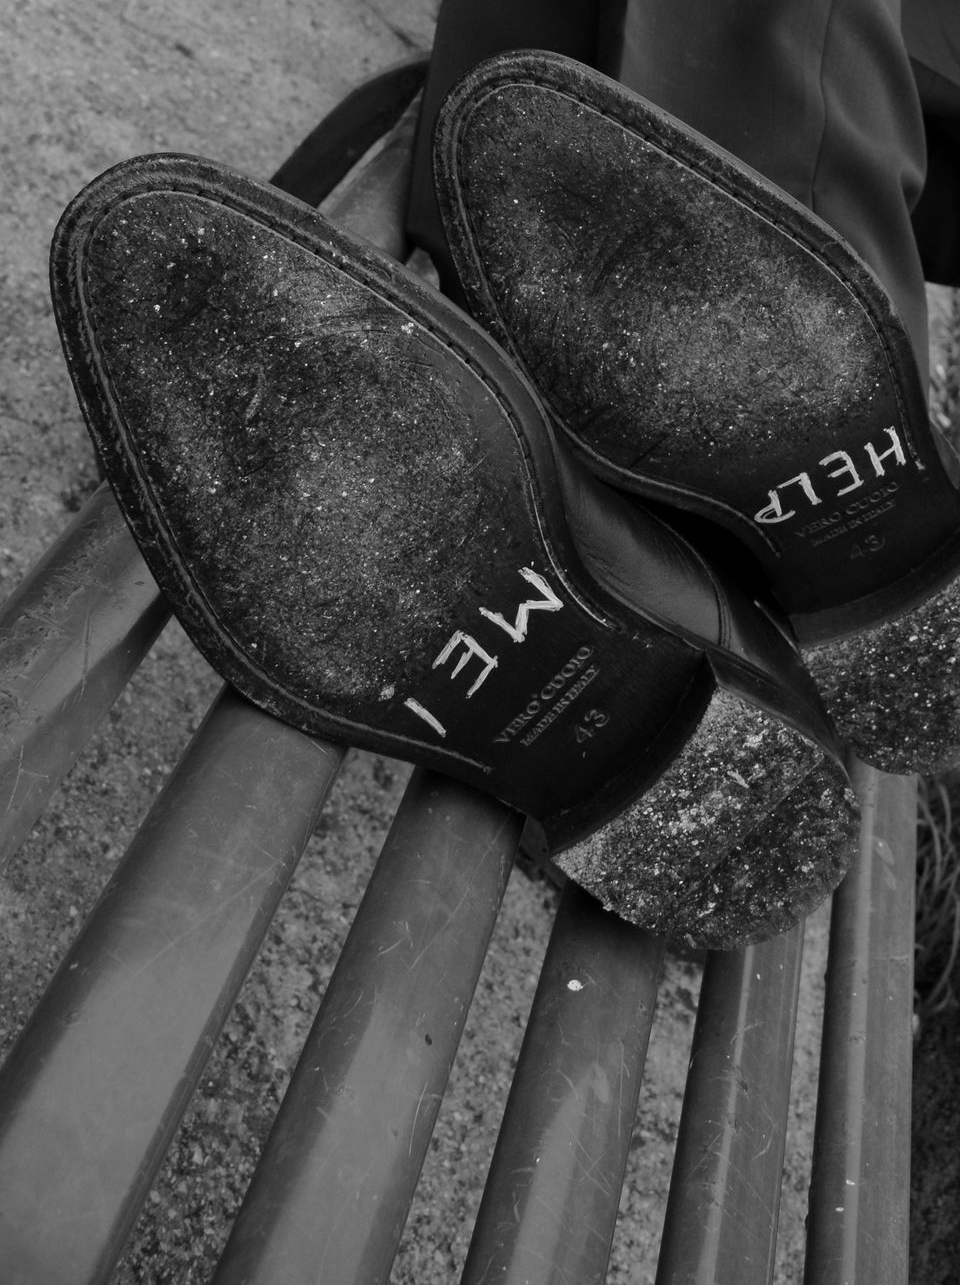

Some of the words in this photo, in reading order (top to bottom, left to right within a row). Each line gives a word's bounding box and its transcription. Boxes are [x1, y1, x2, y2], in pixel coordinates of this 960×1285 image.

[754, 425, 907, 524] HELP
[793, 511, 841, 537] VERO
[845, 481, 899, 515] CUOIO
[810, 523, 849, 548] MADE
[849, 531, 886, 560] 43
[492, 700, 541, 743] VERO
[541, 646, 594, 700] CUOIO
[520, 710, 558, 746] MADE
[564, 664, 601, 701] ITALY
[574, 709, 610, 744] 43
